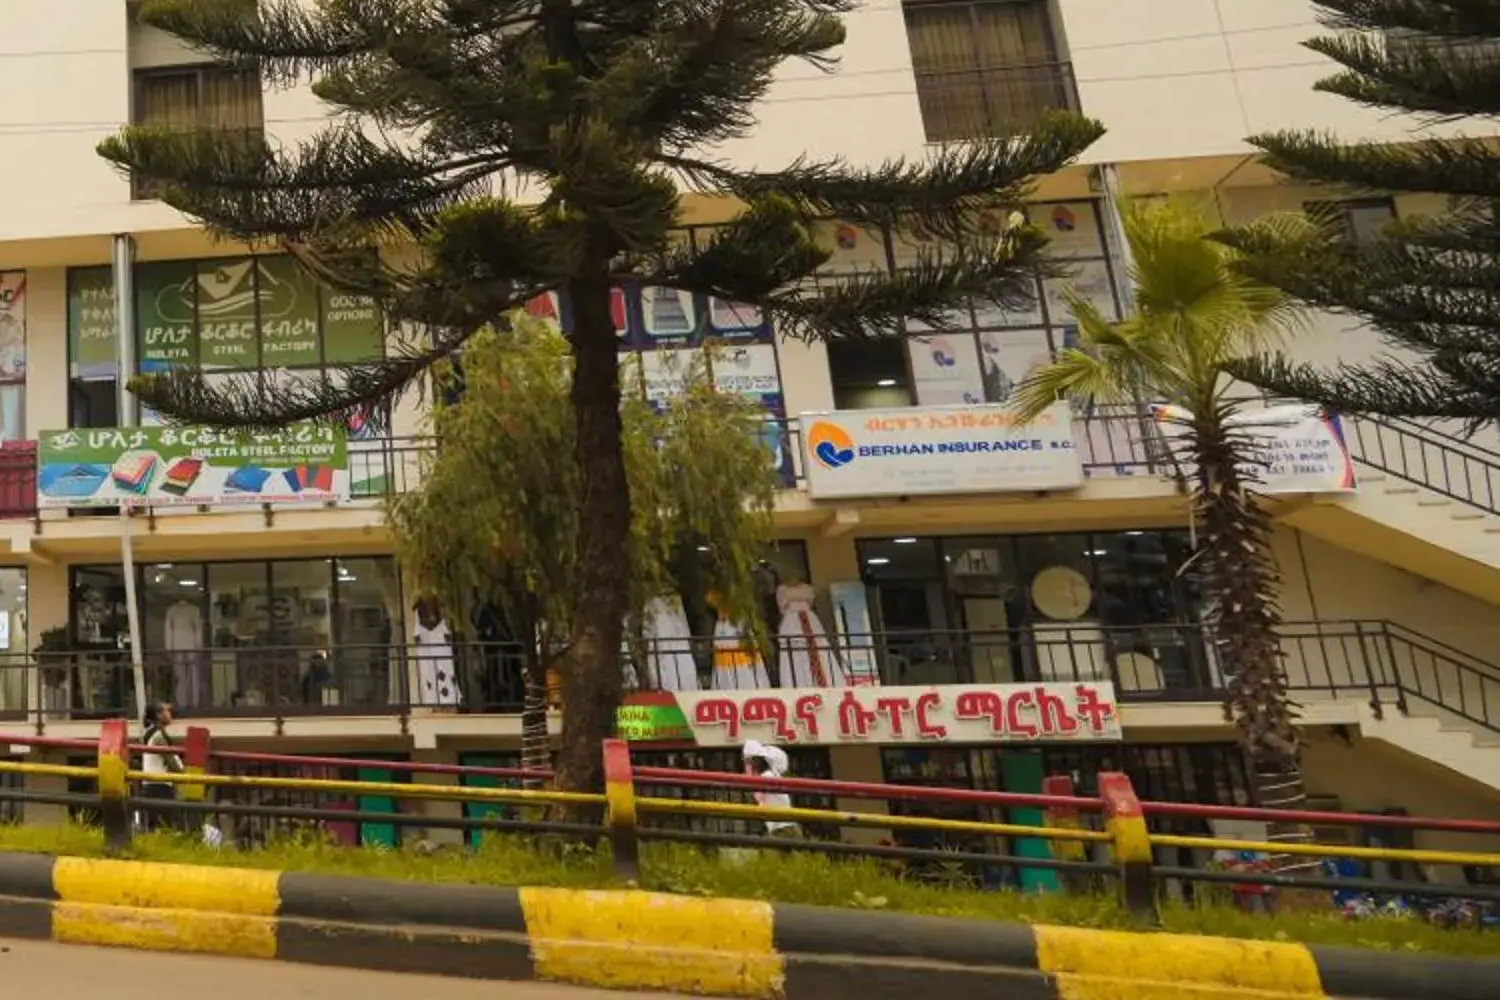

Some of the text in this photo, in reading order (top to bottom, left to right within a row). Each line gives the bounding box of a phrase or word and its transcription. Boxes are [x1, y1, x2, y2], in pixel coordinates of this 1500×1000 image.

[859, 444, 934, 457] BERHAN
[938, 440, 1043, 454] INSURANCE
[695, 685, 1112, 741] ማሚና ሱፐር ማርኬት
